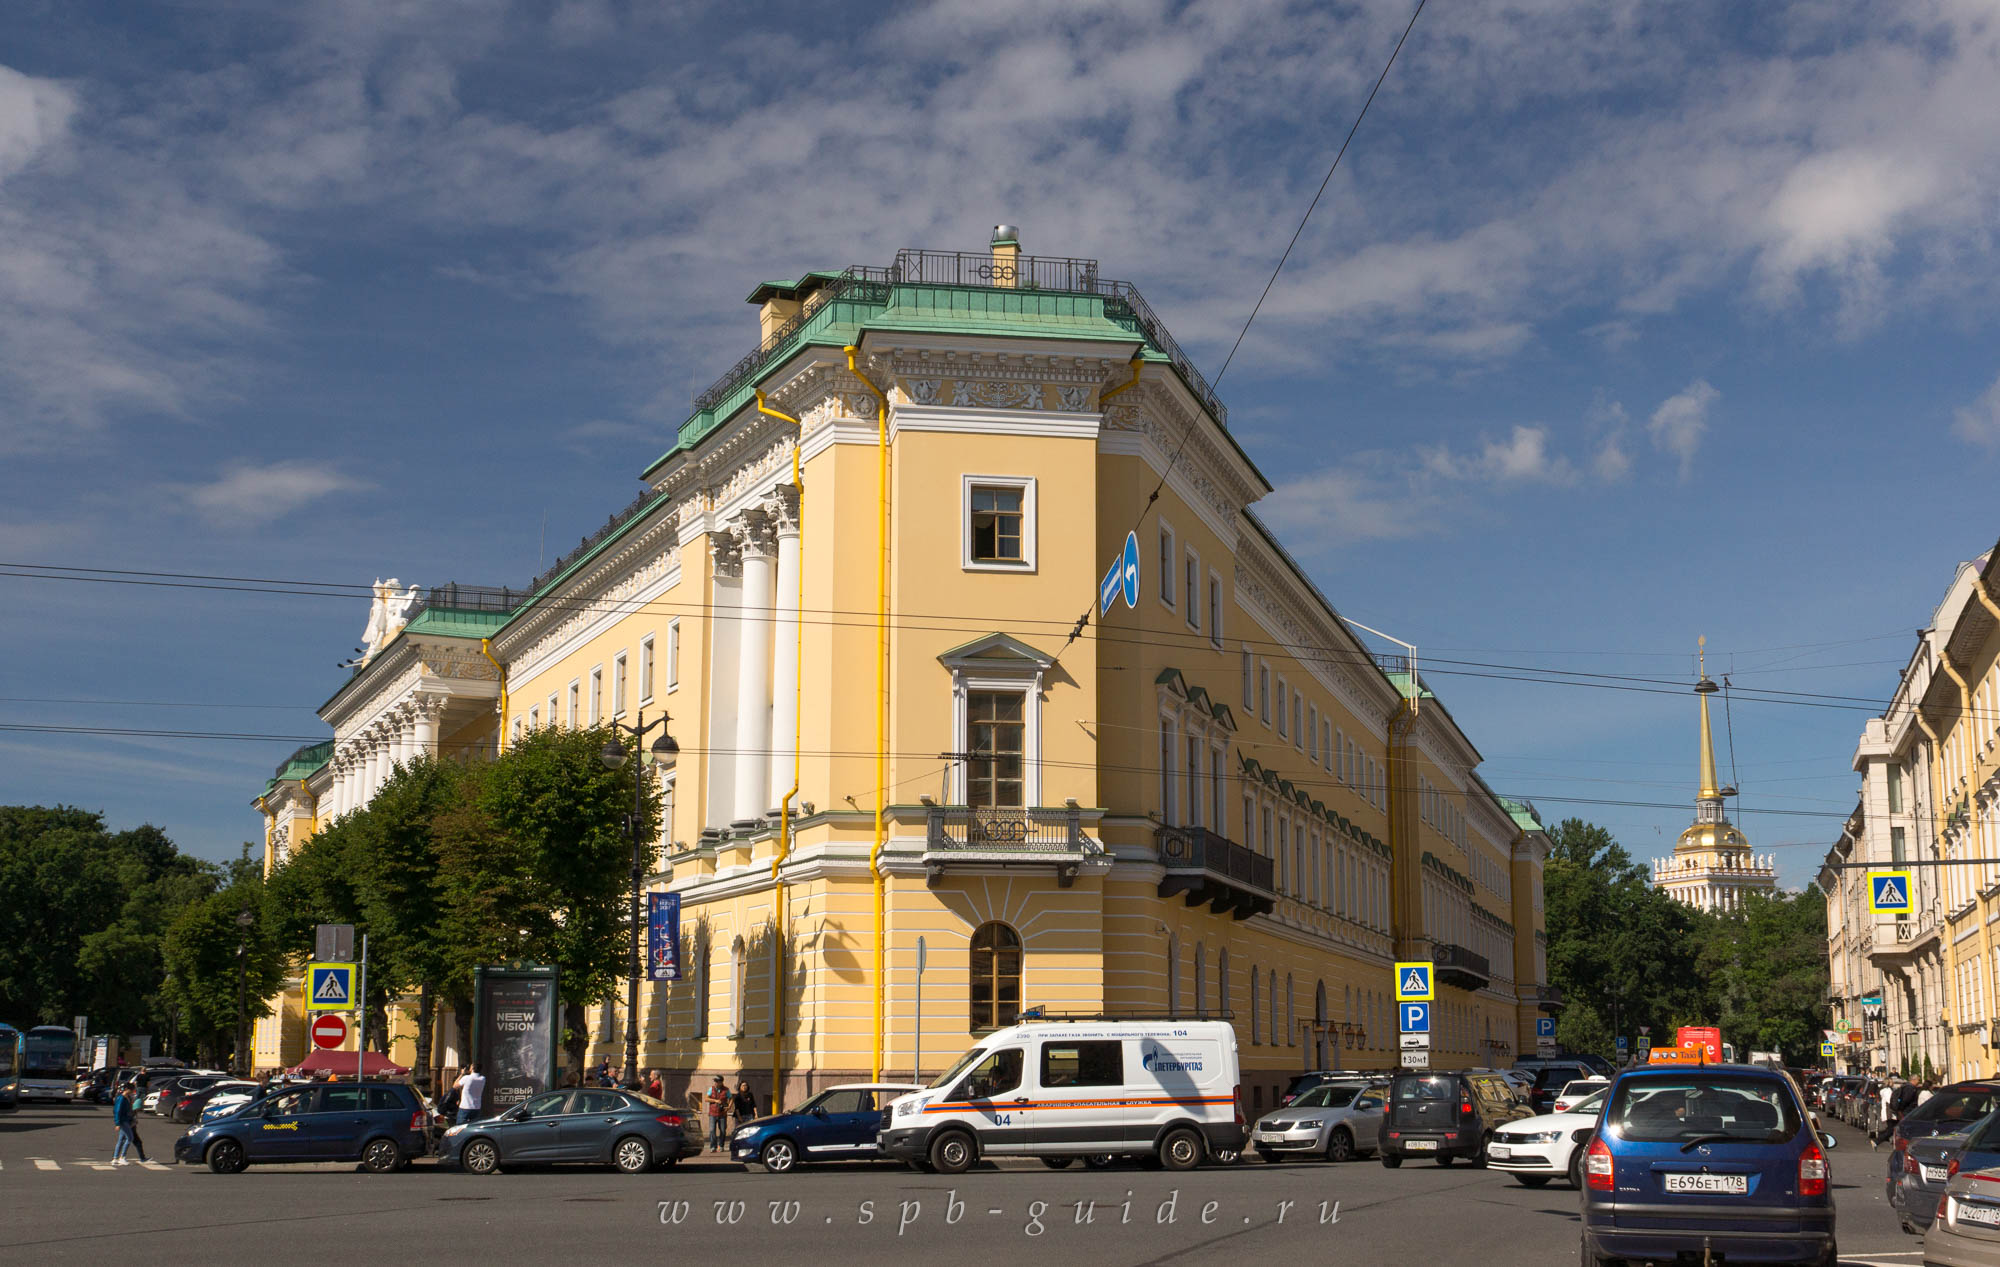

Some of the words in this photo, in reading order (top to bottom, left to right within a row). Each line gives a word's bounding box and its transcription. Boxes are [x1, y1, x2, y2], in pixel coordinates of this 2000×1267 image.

[496, 1012, 536, 1022] NEW
[1408, 1006, 1424, 1029] P
[496, 1022, 535, 1031] VISION
[1541, 1020, 1552, 1035] P
[494, 1086, 533, 1095] НОВЫЙ
[994, 1114, 1011, 1126] 04
[1670, 1176, 1720, 1189] Е696ЕТ
[1723, 1176, 1742, 1186] 178
